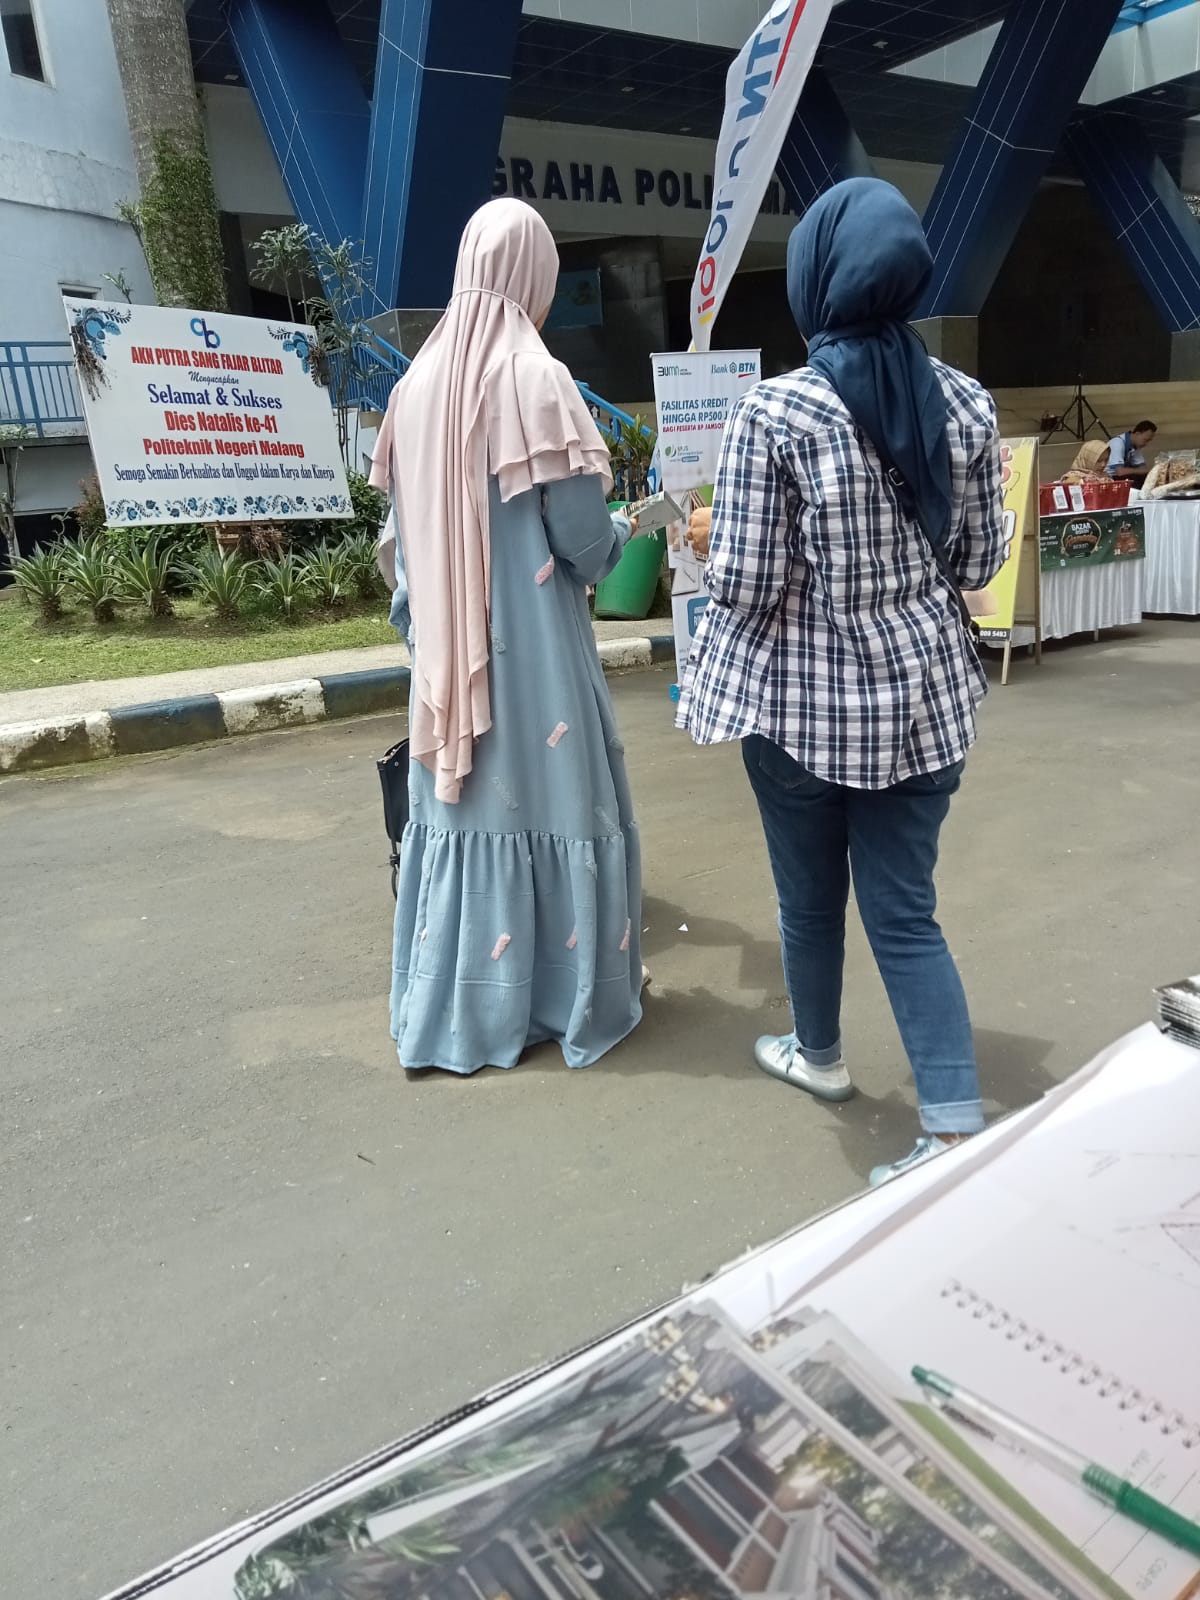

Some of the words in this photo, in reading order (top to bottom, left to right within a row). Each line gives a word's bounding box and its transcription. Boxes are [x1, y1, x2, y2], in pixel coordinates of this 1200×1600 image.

[131, 346, 154, 364] AKN
[157, 349, 189, 367] PUTRA
[192, 351, 220, 370] SANG
[221, 354, 250, 372] FAJAR
[251, 356, 283, 375] BLITAR
[711, 363, 728, 374] Bank
[738, 362, 756, 372] BTN
[188, 371, 239, 385] Mengucapkan
[148, 384, 210, 405] Selamat
[216, 388, 228, 406] &
[234, 389, 282, 409] Sukses
[662, 400, 699, 411] FASILITAS
[702, 397, 728, 409] KREDIT
[164, 410, 195, 431] Dies
[198, 412, 242, 432] Natalis
[245, 414, 278, 434] ke-41
[663, 413, 696, 424] HINGGA
[699, 411, 722, 422] RP500
[143, 438, 212, 455] Politeknik
[216, 440, 258, 456] Negeri
[260, 441, 304, 458] Malang
[114, 464, 146, 483] Semoga
[146, 464, 179, 479] Semakin
[181, 463, 220, 479] Berkualitas
[222, 464, 234, 479] dan
[235, 464, 259, 481] Unggul
[260, 464, 279, 479] dalam
[280, 464, 300, 481] Karya
[300, 465, 311, 479] dan
[312, 465, 335, 481] Kinerja
